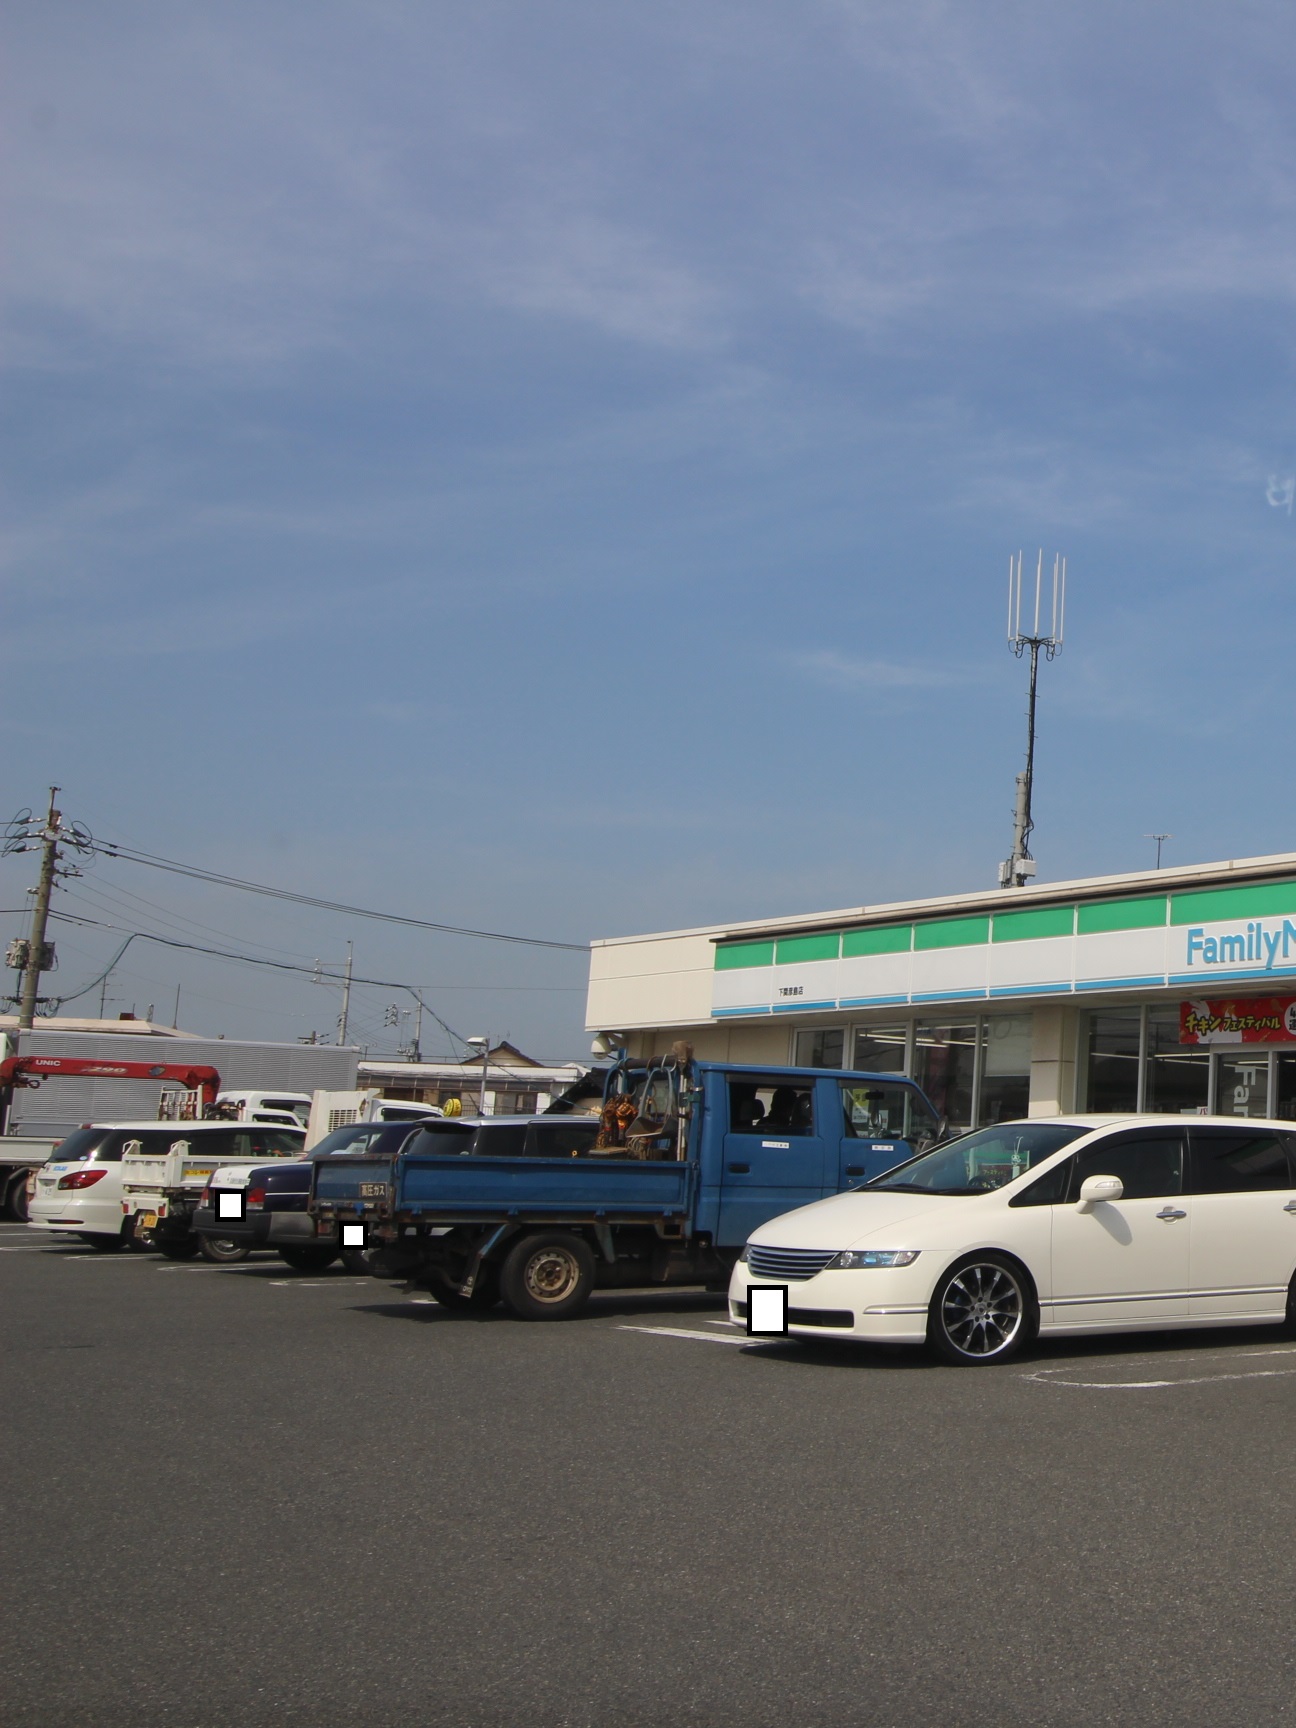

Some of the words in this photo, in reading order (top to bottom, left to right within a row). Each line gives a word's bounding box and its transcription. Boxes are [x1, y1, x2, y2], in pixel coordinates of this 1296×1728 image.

[35, 1059, 61, 1067] UNIC
[361, 1184, 385, 1197] 高圧ガス
